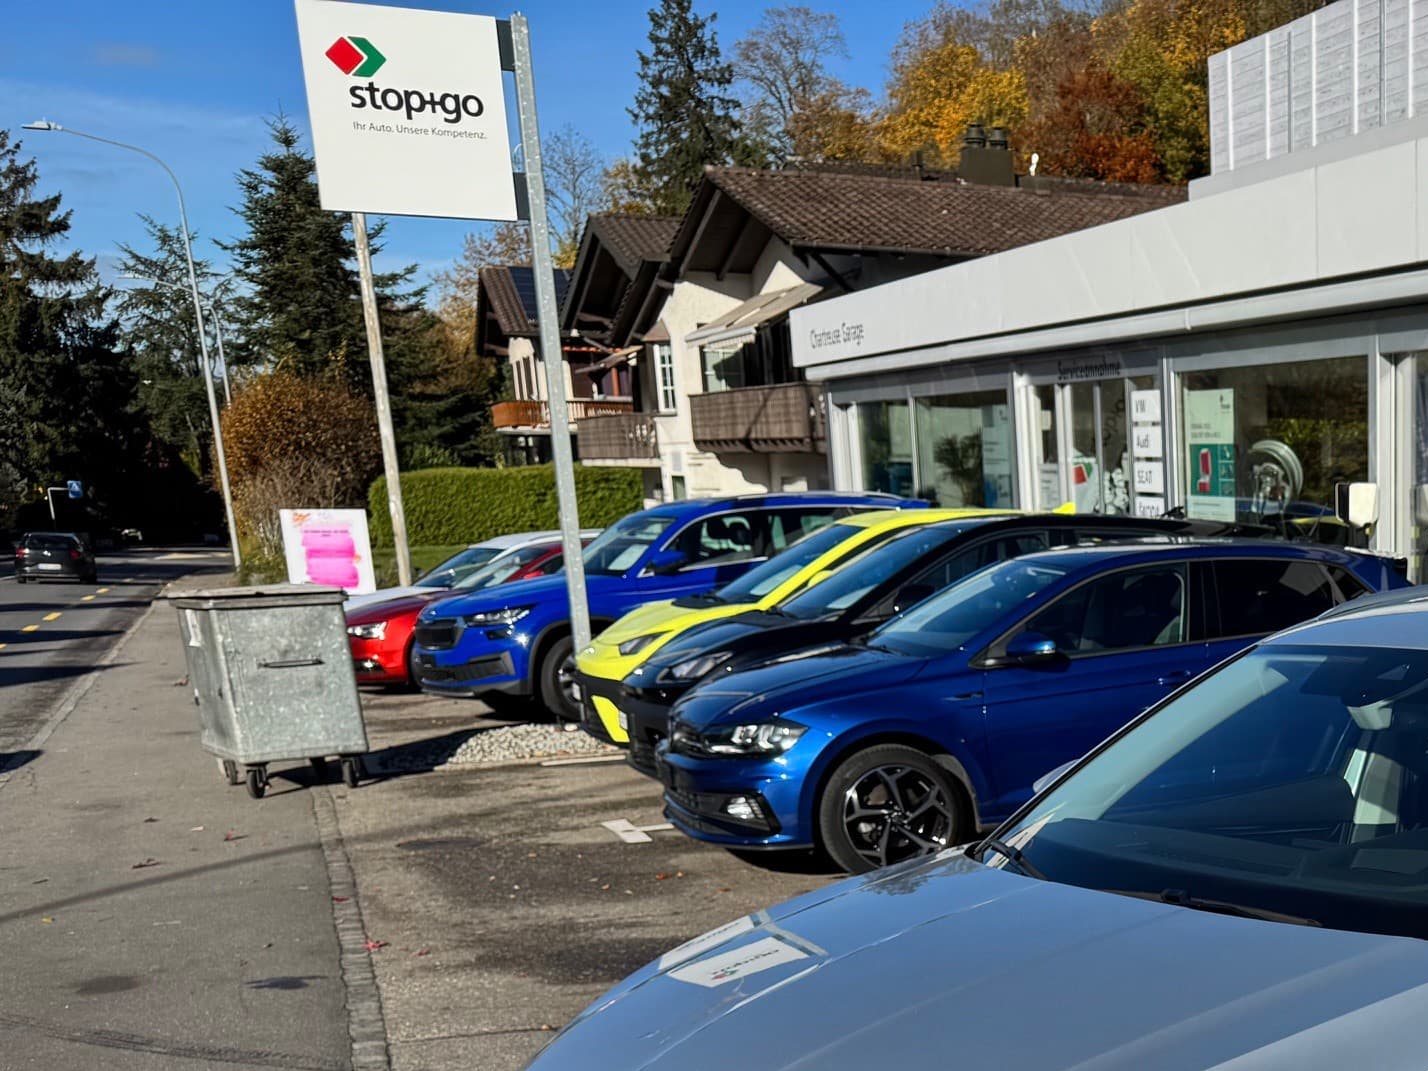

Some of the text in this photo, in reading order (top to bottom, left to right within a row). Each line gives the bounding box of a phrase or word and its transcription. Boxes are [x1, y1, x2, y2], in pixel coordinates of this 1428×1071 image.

[349, 81, 484, 124] stop+go
[353, 121, 487, 139] Ihr Auto. Unsere Kompetenz.
